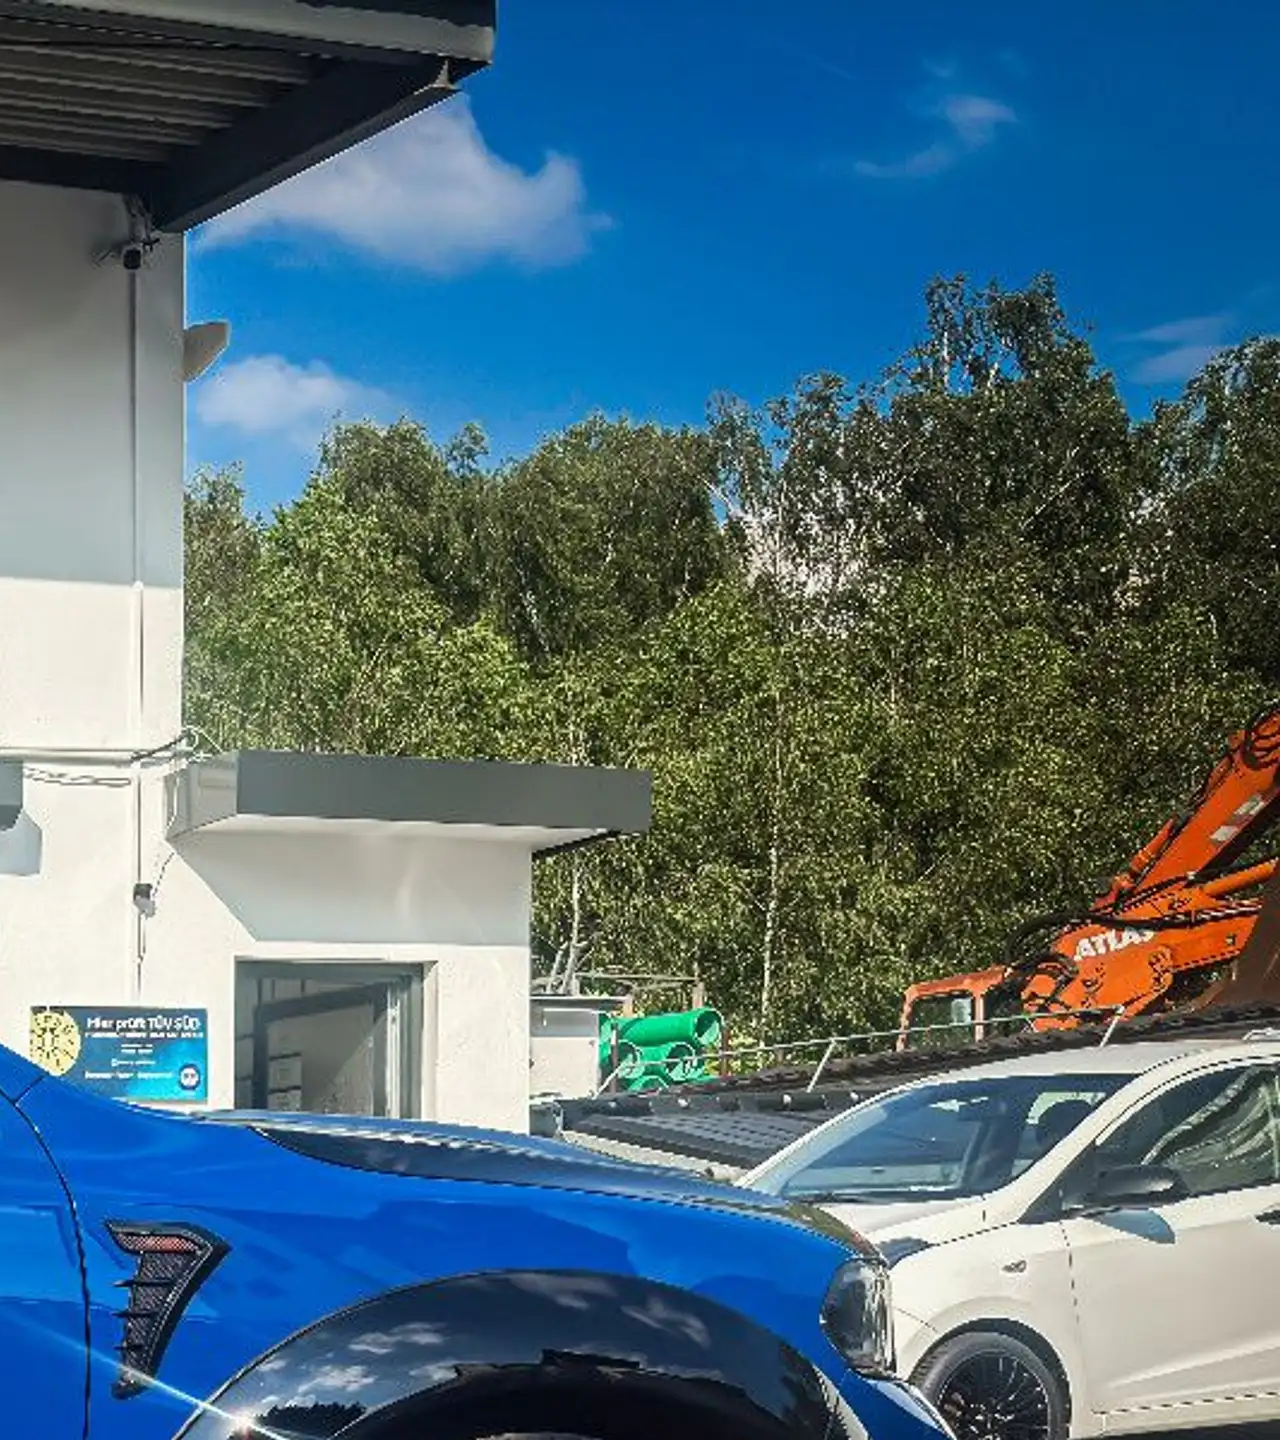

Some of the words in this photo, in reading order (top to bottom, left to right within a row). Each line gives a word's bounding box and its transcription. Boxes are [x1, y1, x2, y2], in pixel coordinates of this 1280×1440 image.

[86, 1016, 114, 1030] Hier
[115, 1016, 146, 1033] prüft
[147, 1014, 173, 1030] TÜV
[174, 1014, 201, 1031] SÜD
